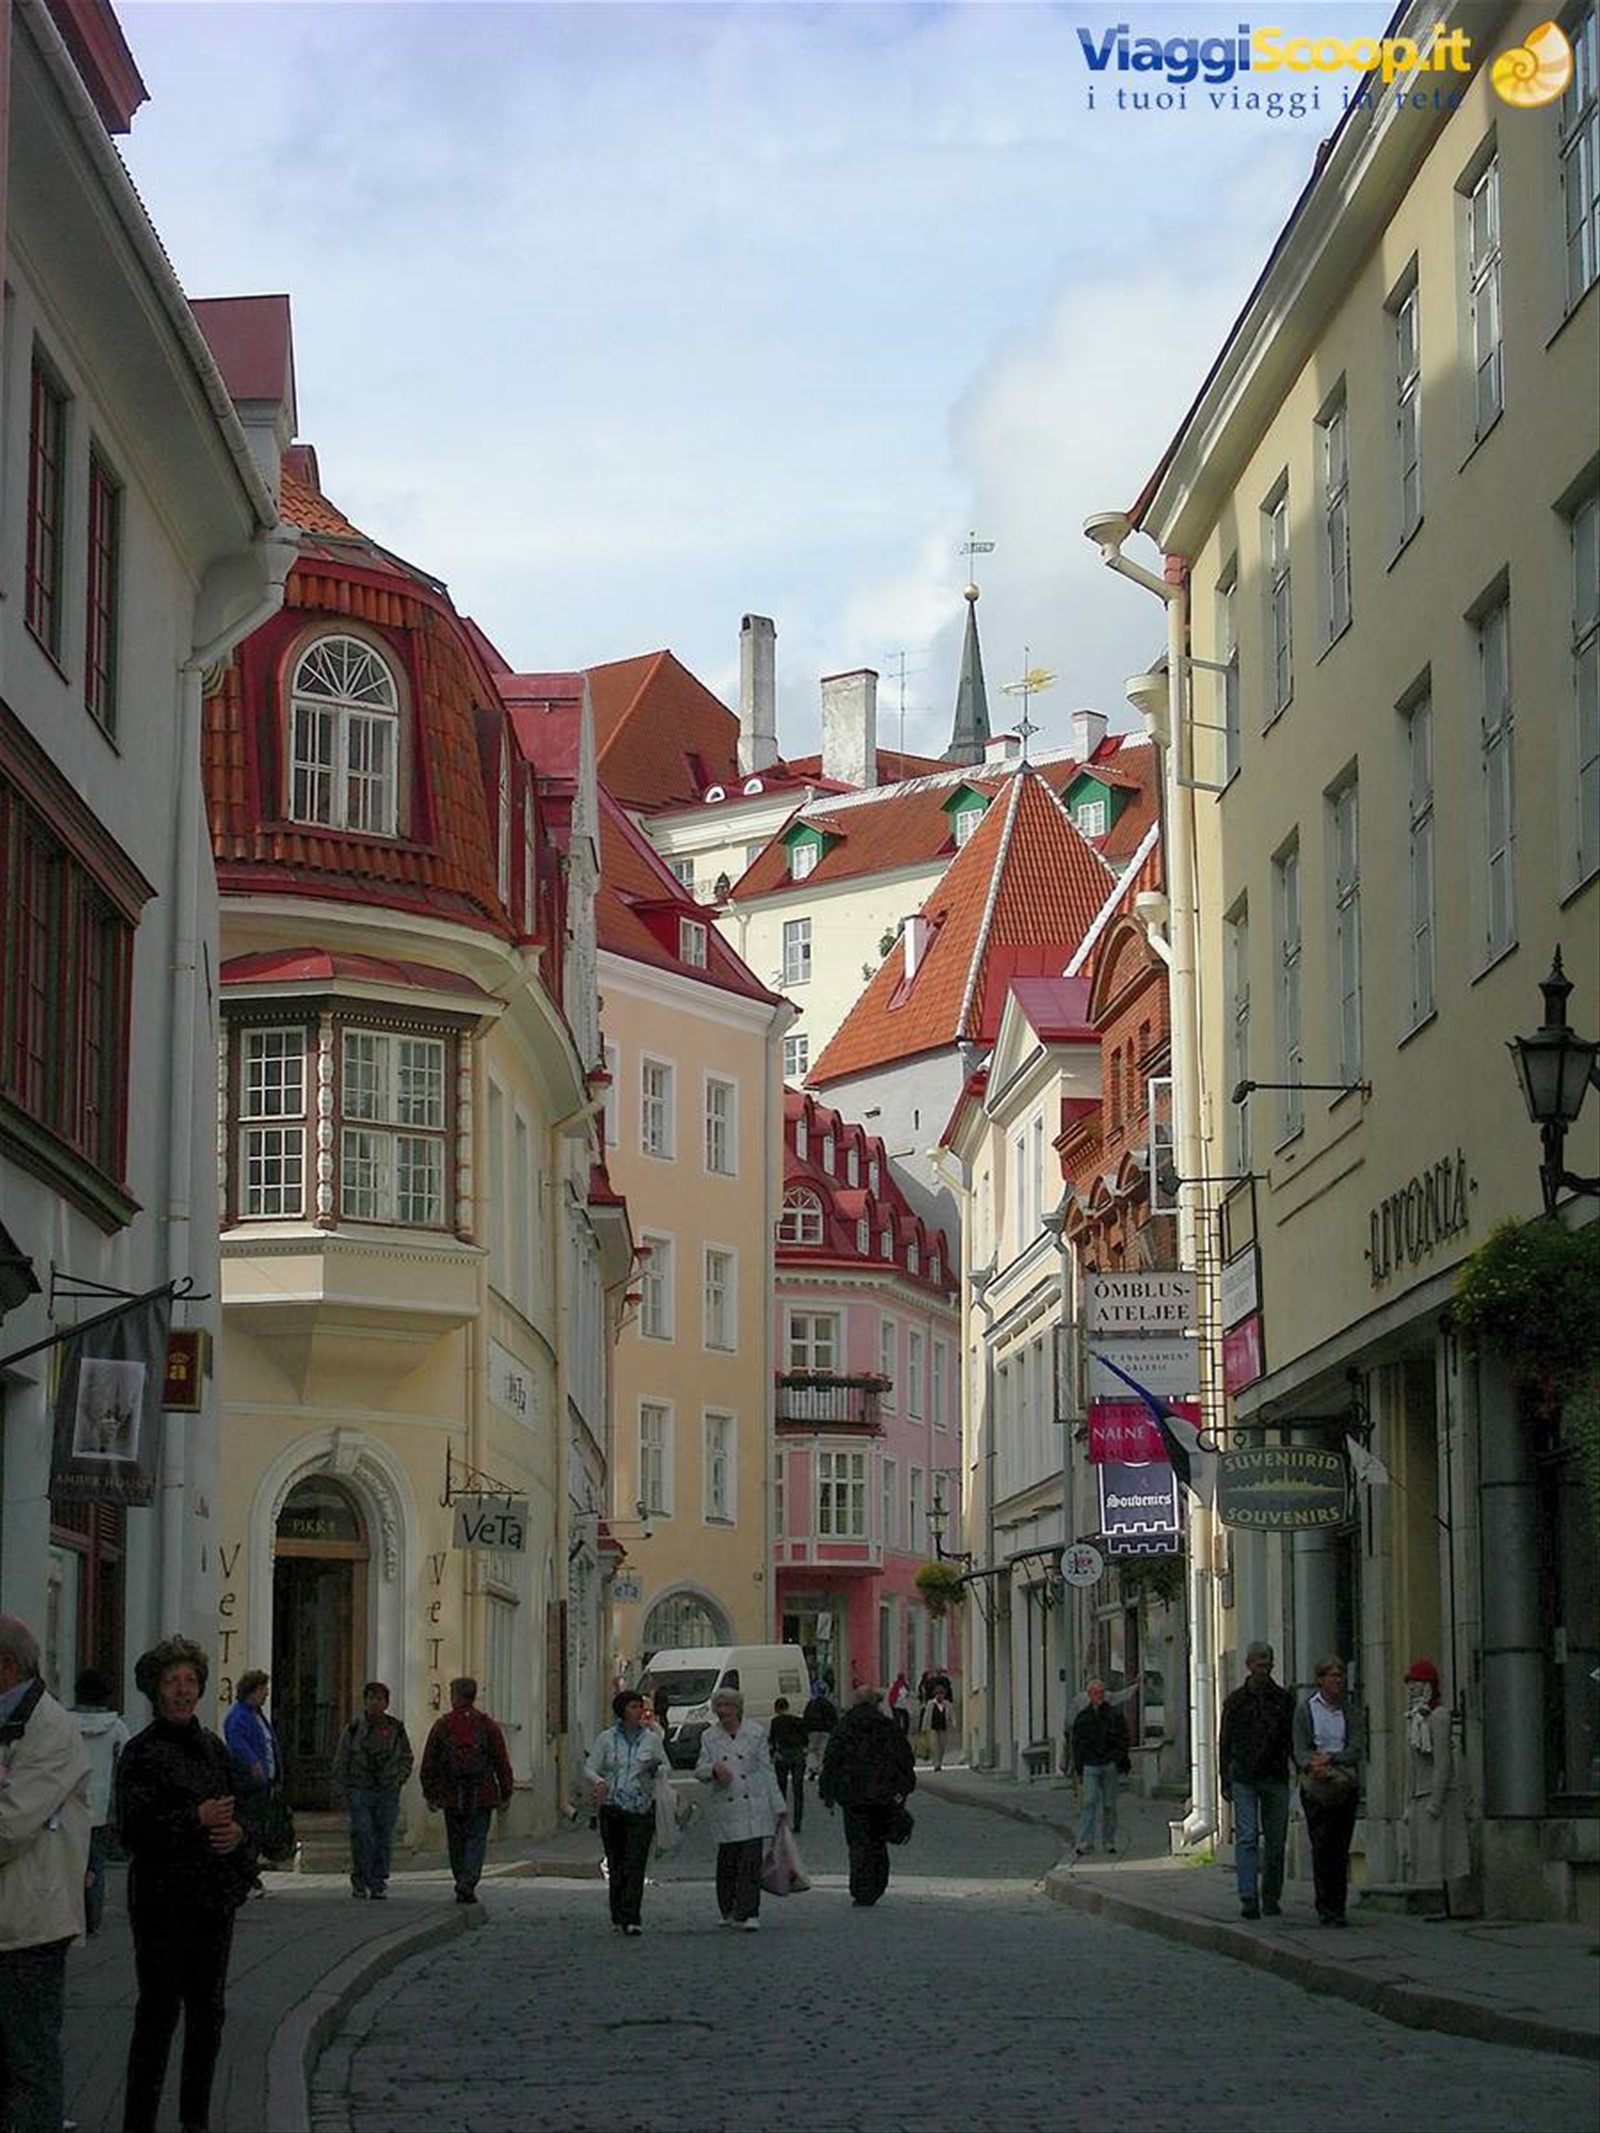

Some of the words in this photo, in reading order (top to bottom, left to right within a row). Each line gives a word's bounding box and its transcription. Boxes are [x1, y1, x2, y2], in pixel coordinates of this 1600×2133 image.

[1096, 1304, 1190, 1321] ATELJEE
[1224, 1451, 1340, 1473] SUVENIIRID
[1106, 1492, 1172, 1509] Souvenirs
[1226, 1505, 1341, 1525] SOUVENIRS
